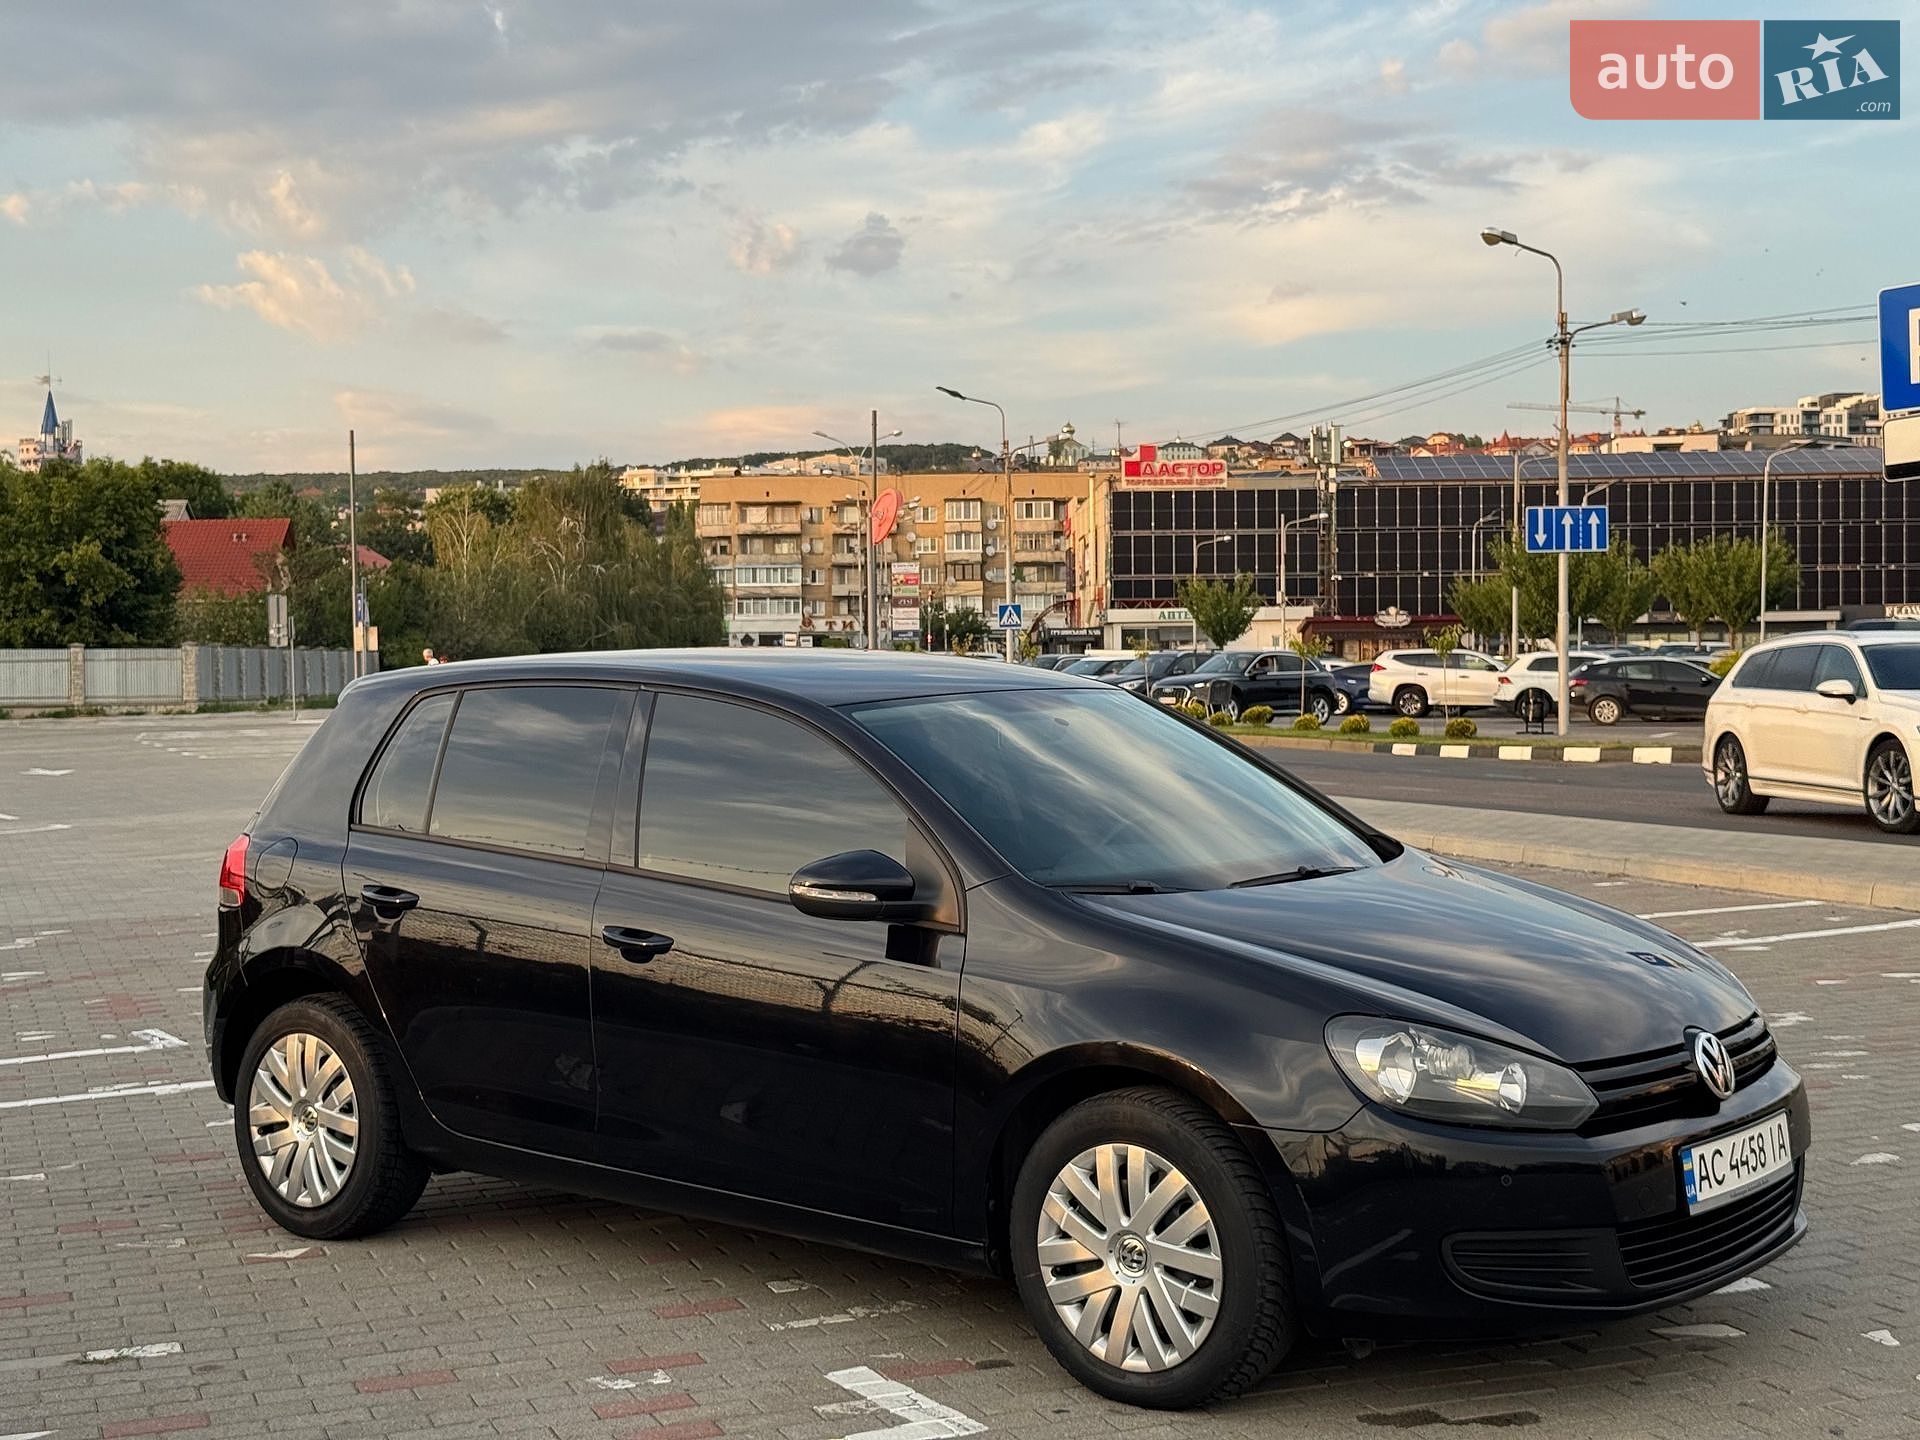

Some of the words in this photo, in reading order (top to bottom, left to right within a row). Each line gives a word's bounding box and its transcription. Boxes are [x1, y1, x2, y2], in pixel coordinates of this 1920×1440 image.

[1142, 462, 1224, 477] ДАСТОР
[1158, 610, 1191, 620] АПТЕ
[1698, 1149, 1726, 1193] AC
[1729, 1132, 1767, 1179] 4458
[1770, 1122, 1787, 1164] IA
[1685, 1183, 1697, 1198] UA
